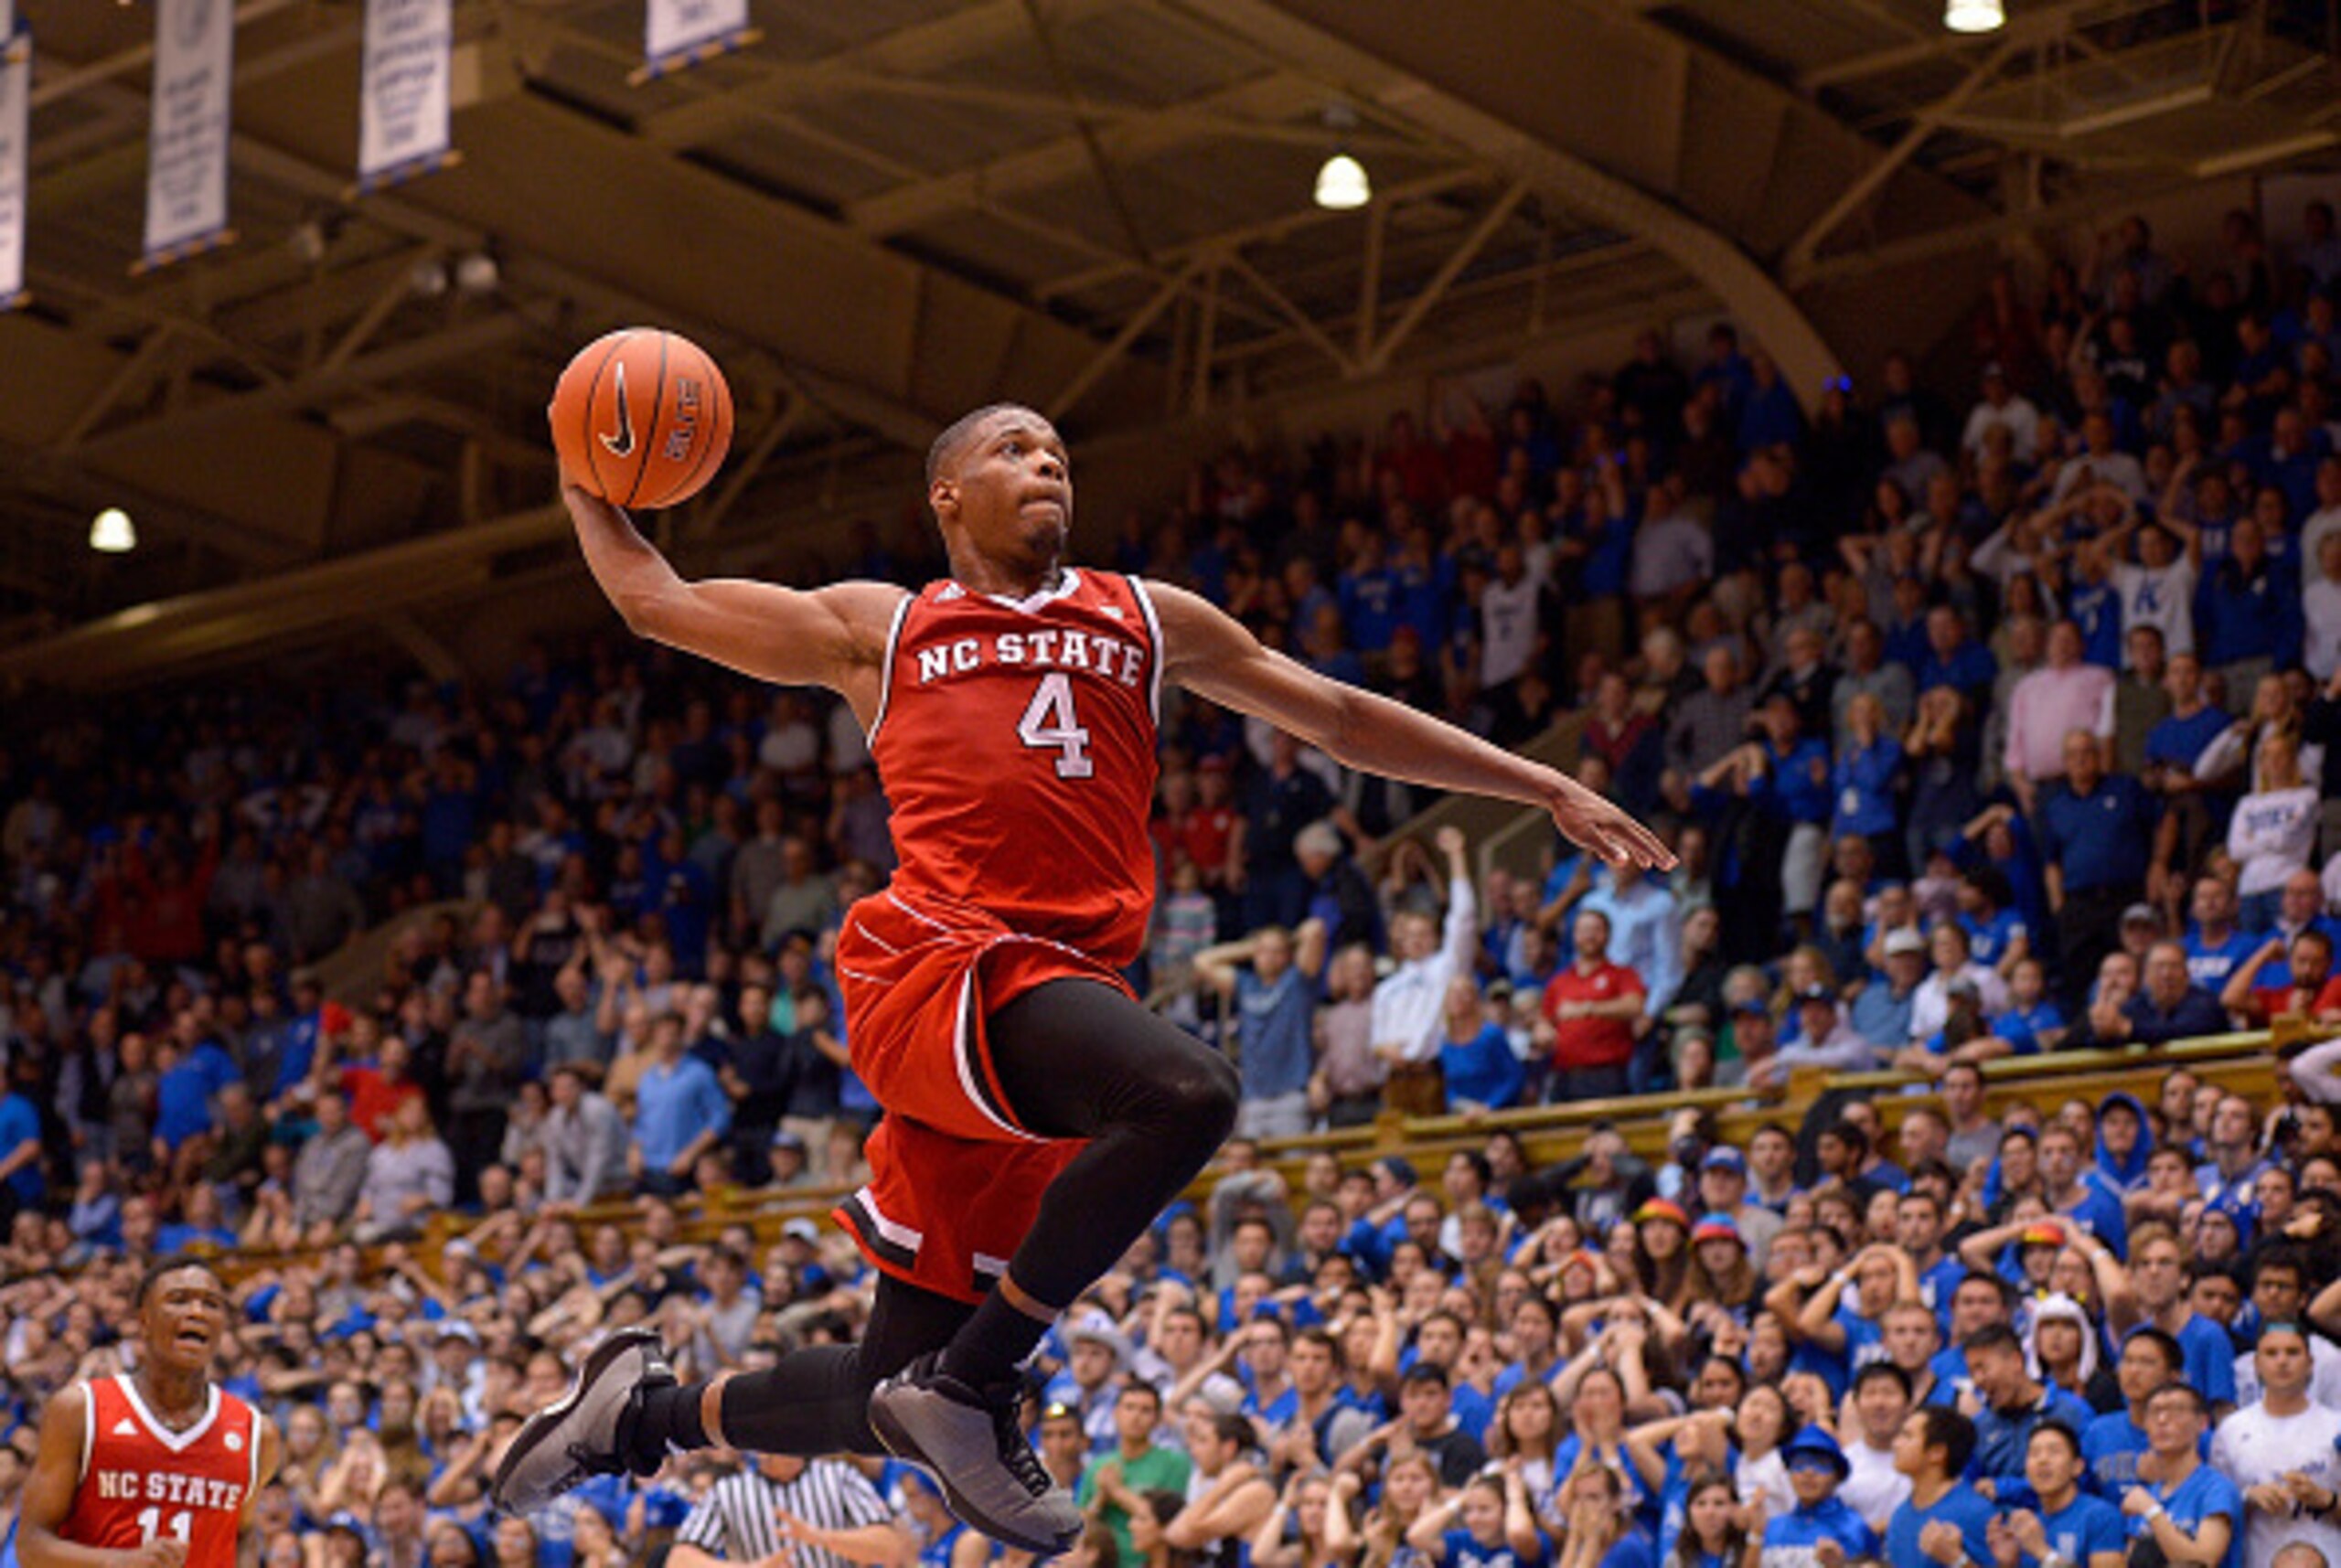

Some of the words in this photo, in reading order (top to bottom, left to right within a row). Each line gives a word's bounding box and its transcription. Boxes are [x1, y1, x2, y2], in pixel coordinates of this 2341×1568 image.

[662, 376, 701, 462] ELITE
[917, 639, 981, 684] NC
[995, 630, 1145, 687] STATE
[1016, 671, 1094, 778] 4
[98, 1469, 139, 1499] NC
[145, 1471, 241, 1511] STATE
[137, 1506, 194, 1545] 11
